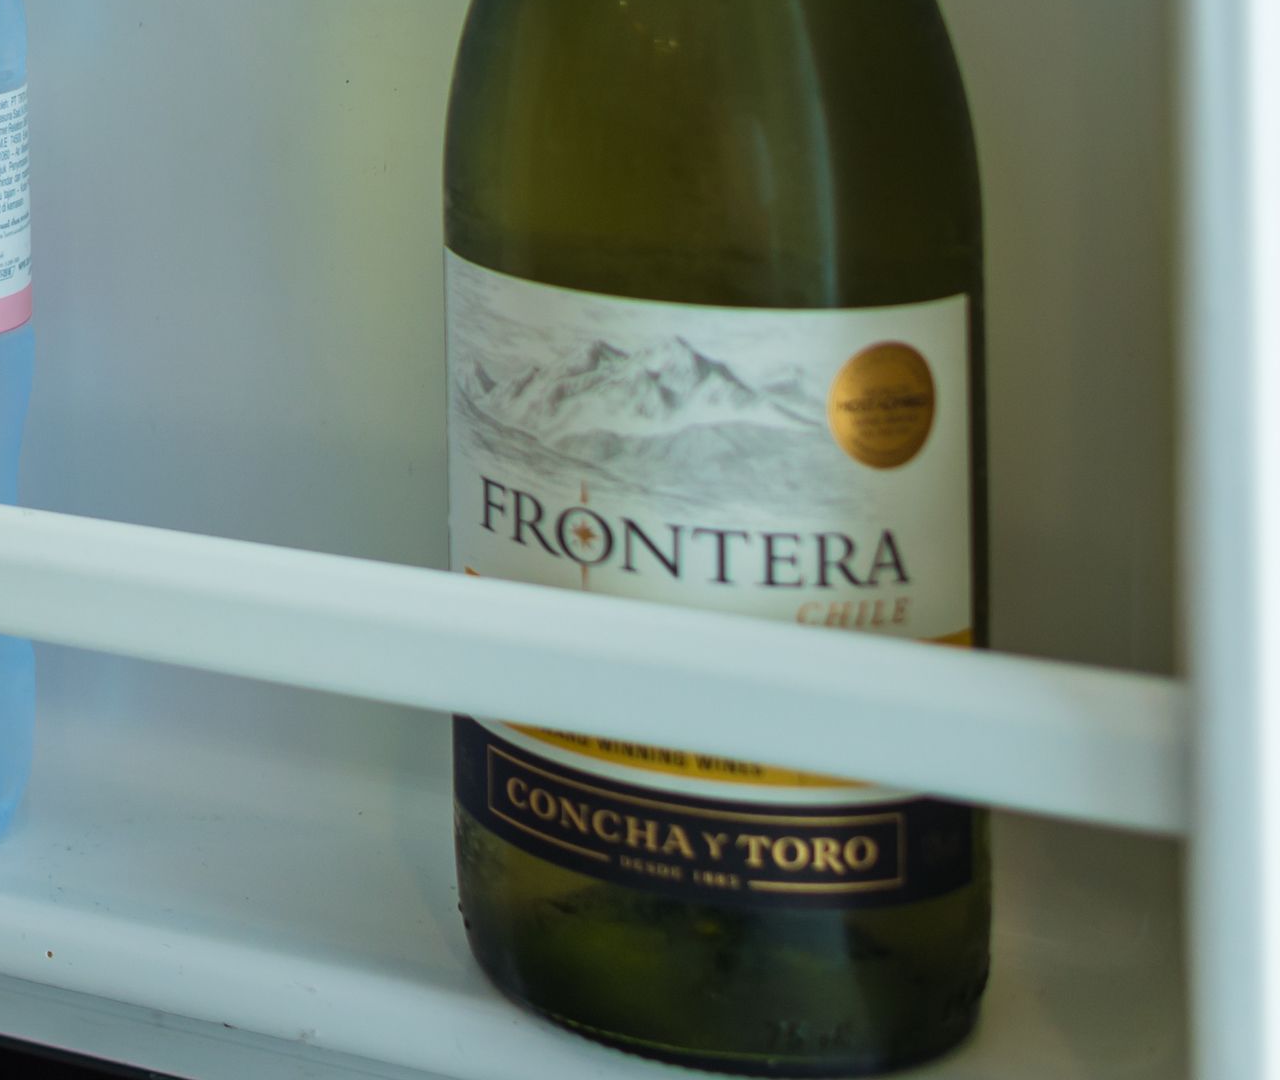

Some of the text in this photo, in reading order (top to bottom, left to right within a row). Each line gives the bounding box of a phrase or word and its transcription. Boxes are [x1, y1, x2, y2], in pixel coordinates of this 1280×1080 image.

[480, 475, 910, 589] FRONTERA
[795, 595, 913, 629] CHILE
[505, 775, 880, 875] CONCHA Y TORO
